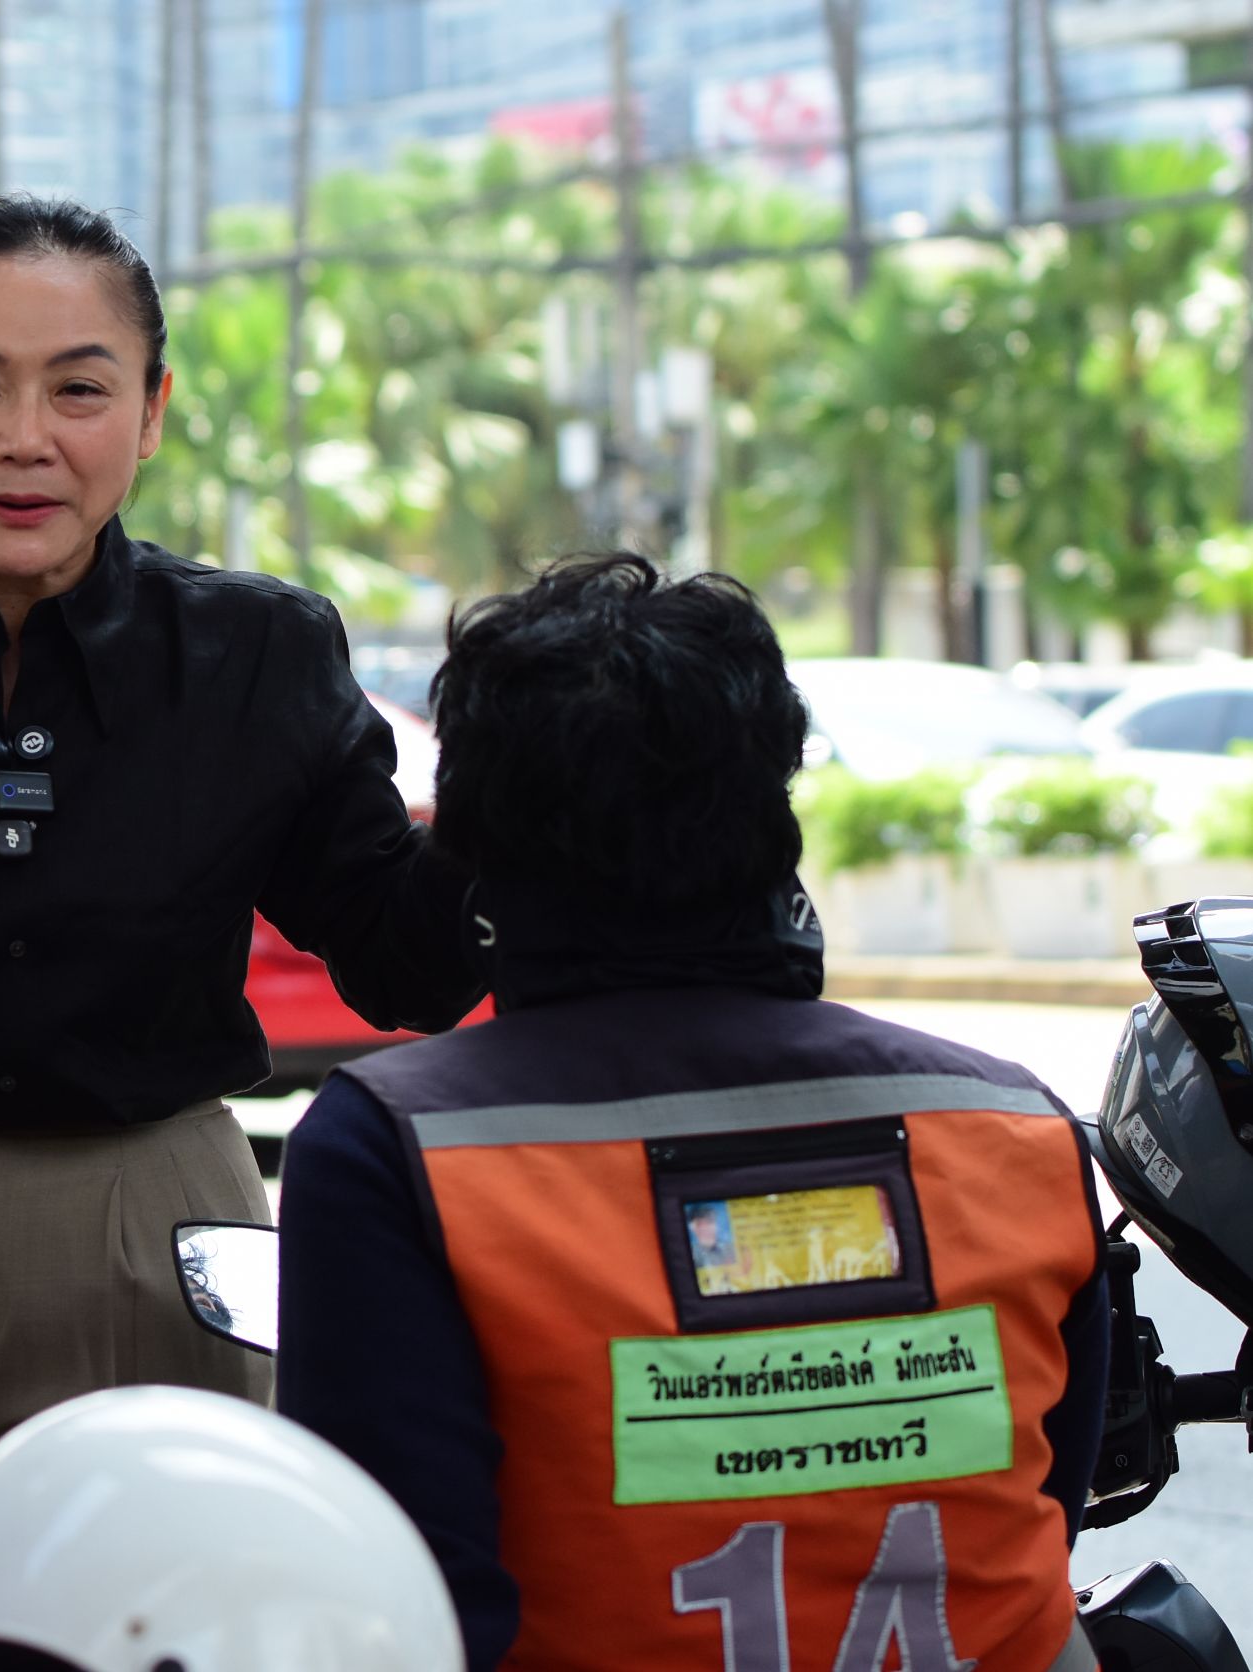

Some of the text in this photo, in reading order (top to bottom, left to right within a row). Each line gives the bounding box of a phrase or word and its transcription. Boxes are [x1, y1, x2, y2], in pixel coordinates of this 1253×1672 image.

[895, 1333, 976, 1382] มักกะสัน
[715, 1416, 928, 1476] เขตราชเทวี
[671, 1501, 978, 1672] 14
